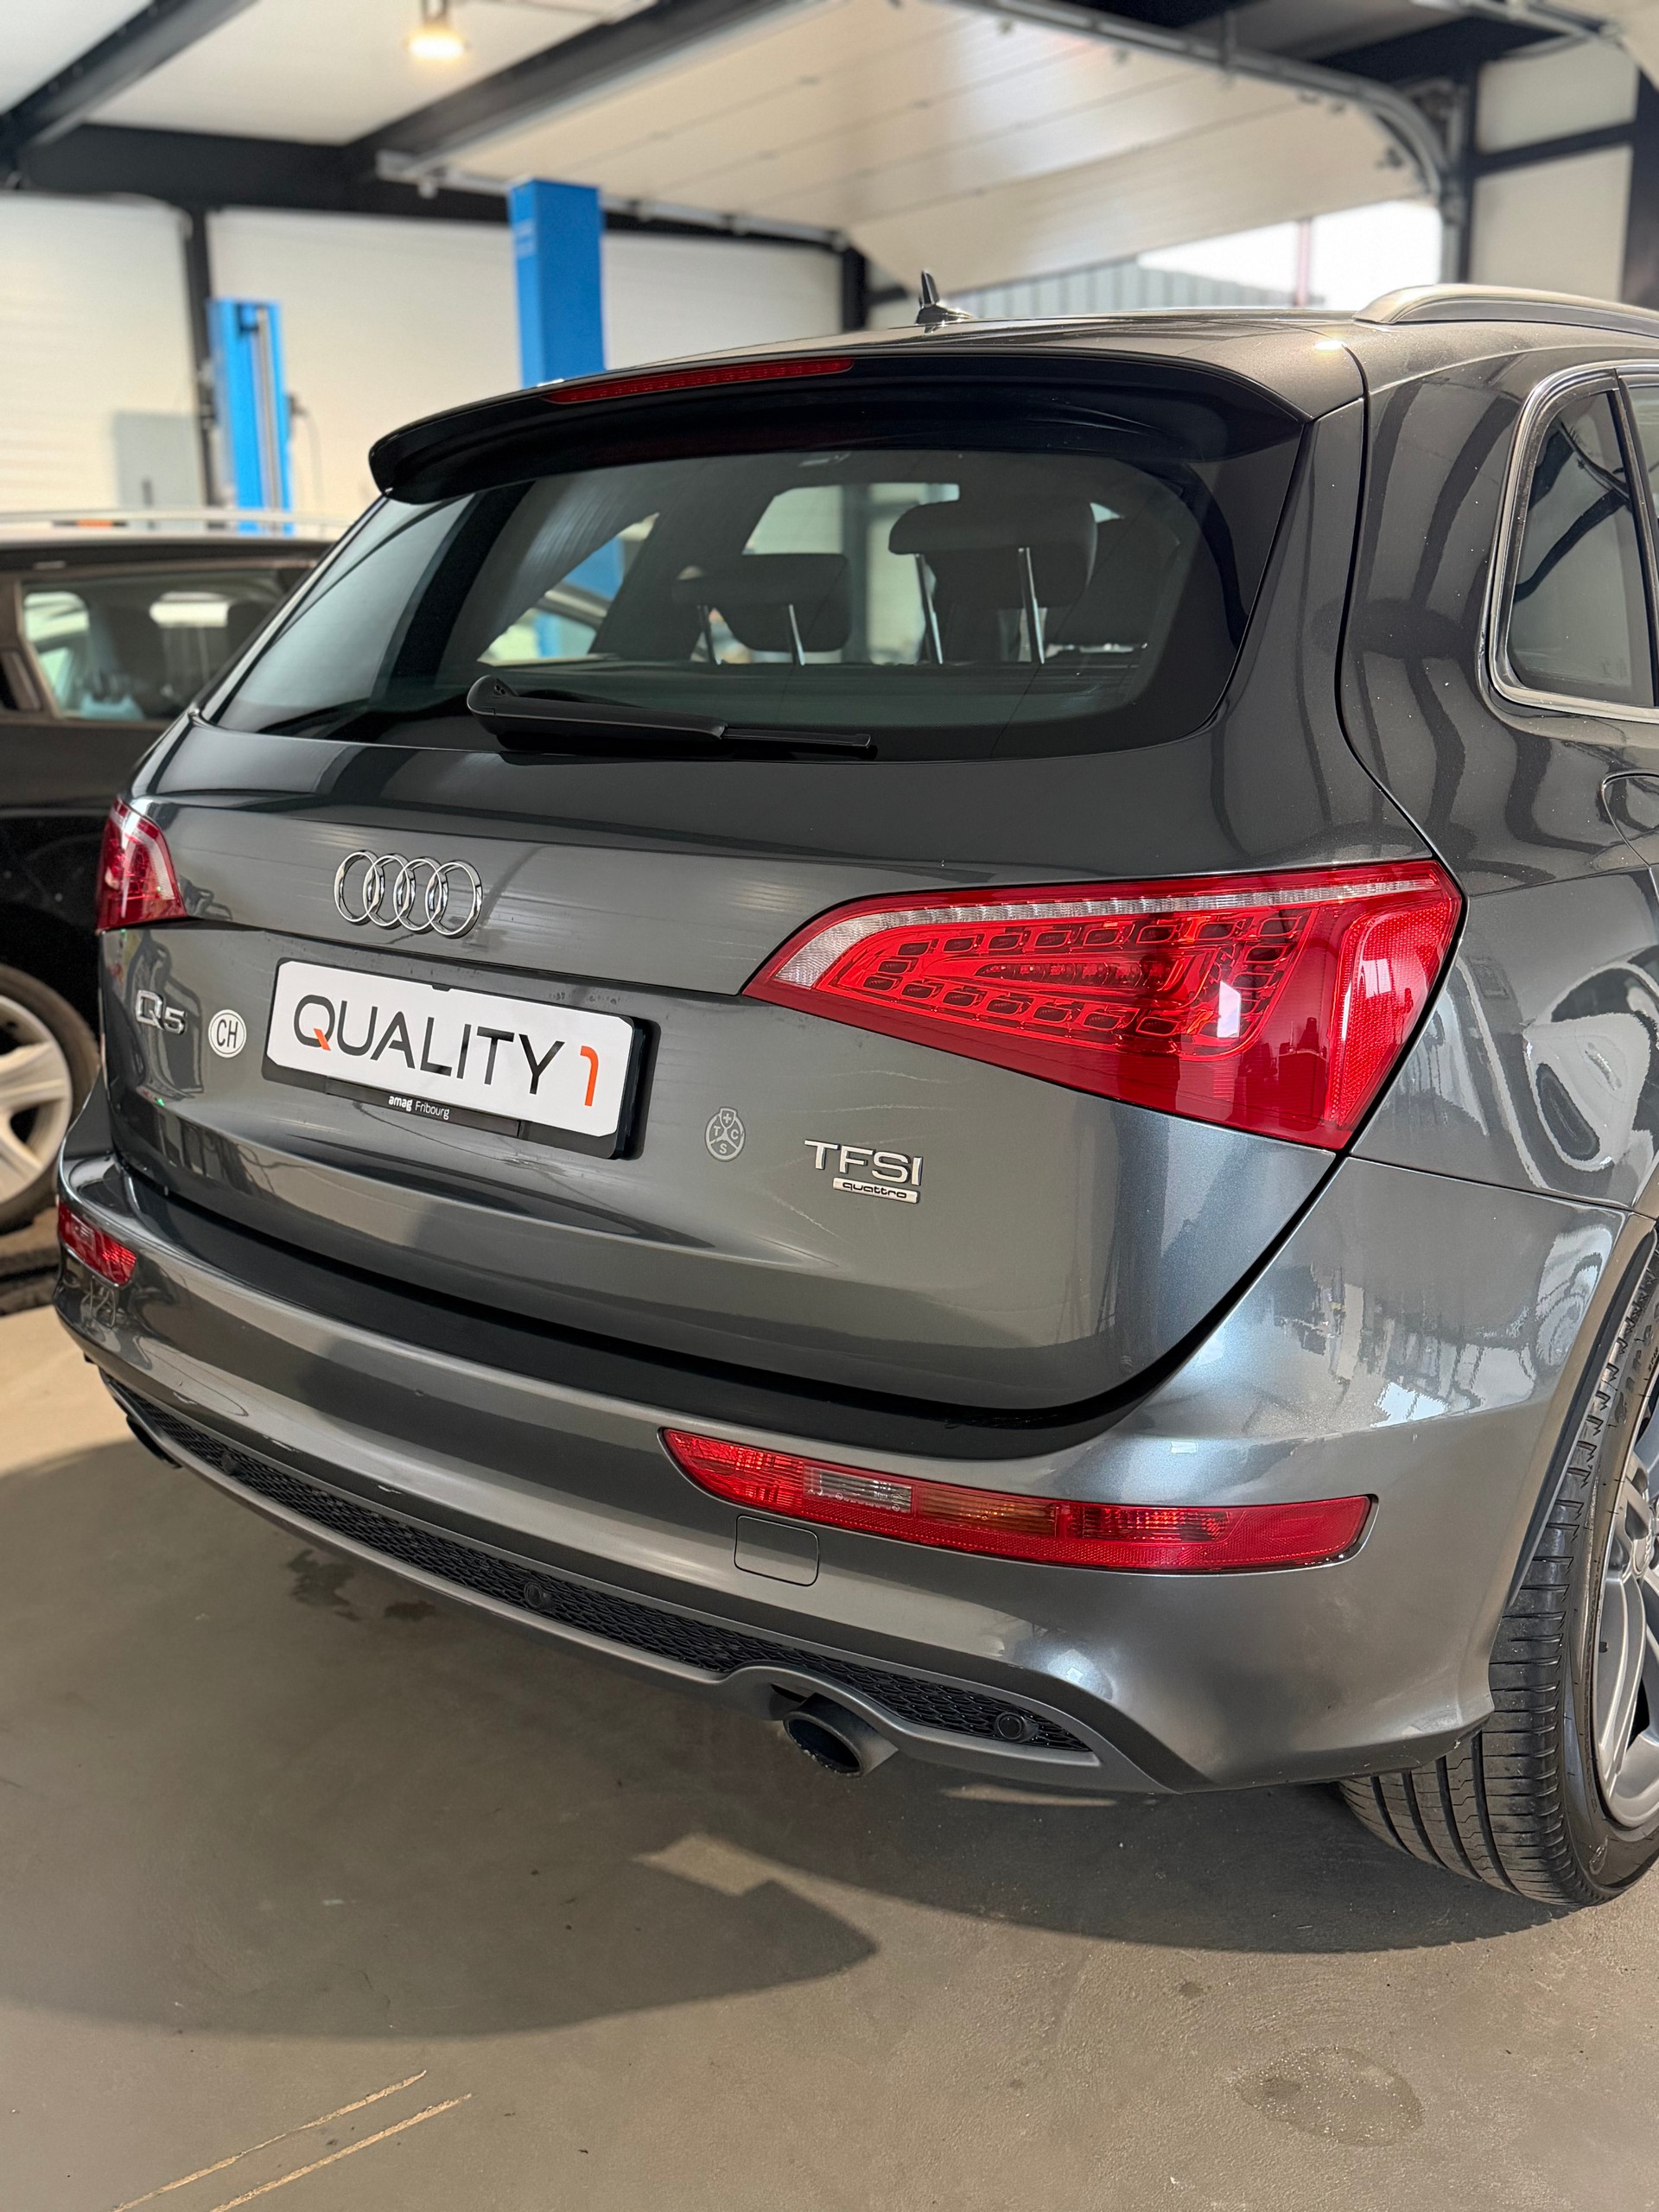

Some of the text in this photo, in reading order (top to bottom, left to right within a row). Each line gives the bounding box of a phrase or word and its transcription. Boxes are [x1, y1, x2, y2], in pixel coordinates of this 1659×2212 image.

[136, 989, 186, 1035] Q5
[216, 1019, 239, 1049] CH
[293, 994, 565, 1095] QUALITY
[388, 1096, 449, 1121] amag Fribourg
[804, 1139, 923, 1186] TFSI
[842, 1181, 907, 1199] quattro
